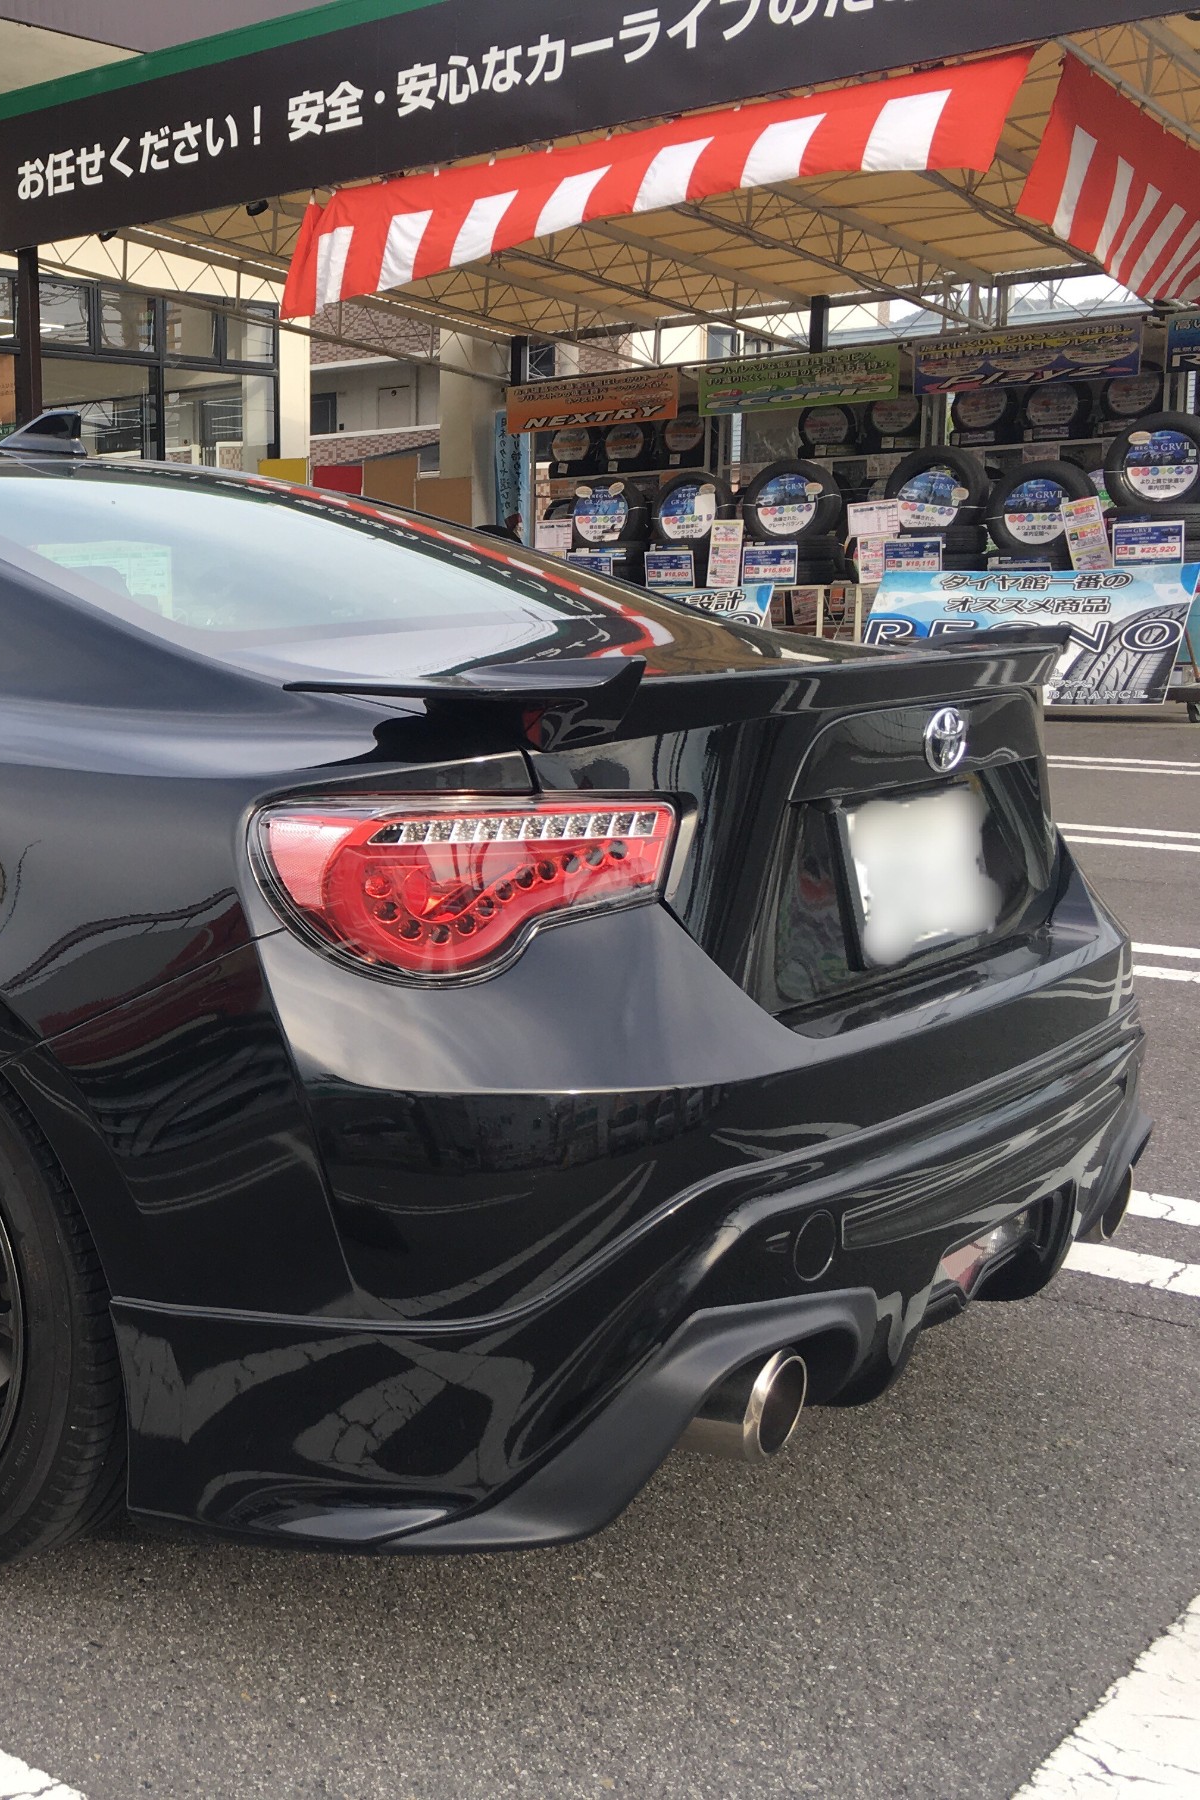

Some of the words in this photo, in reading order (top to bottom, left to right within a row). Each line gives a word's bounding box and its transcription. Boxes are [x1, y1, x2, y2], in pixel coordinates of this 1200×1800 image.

[523, 405, 665, 429] NEXTRY
[1140, 545, 1177, 554] ¥25,920
[940, 573, 1133, 591] タイヤ館一番の
[944, 596, 1111, 614] オススメ商品
